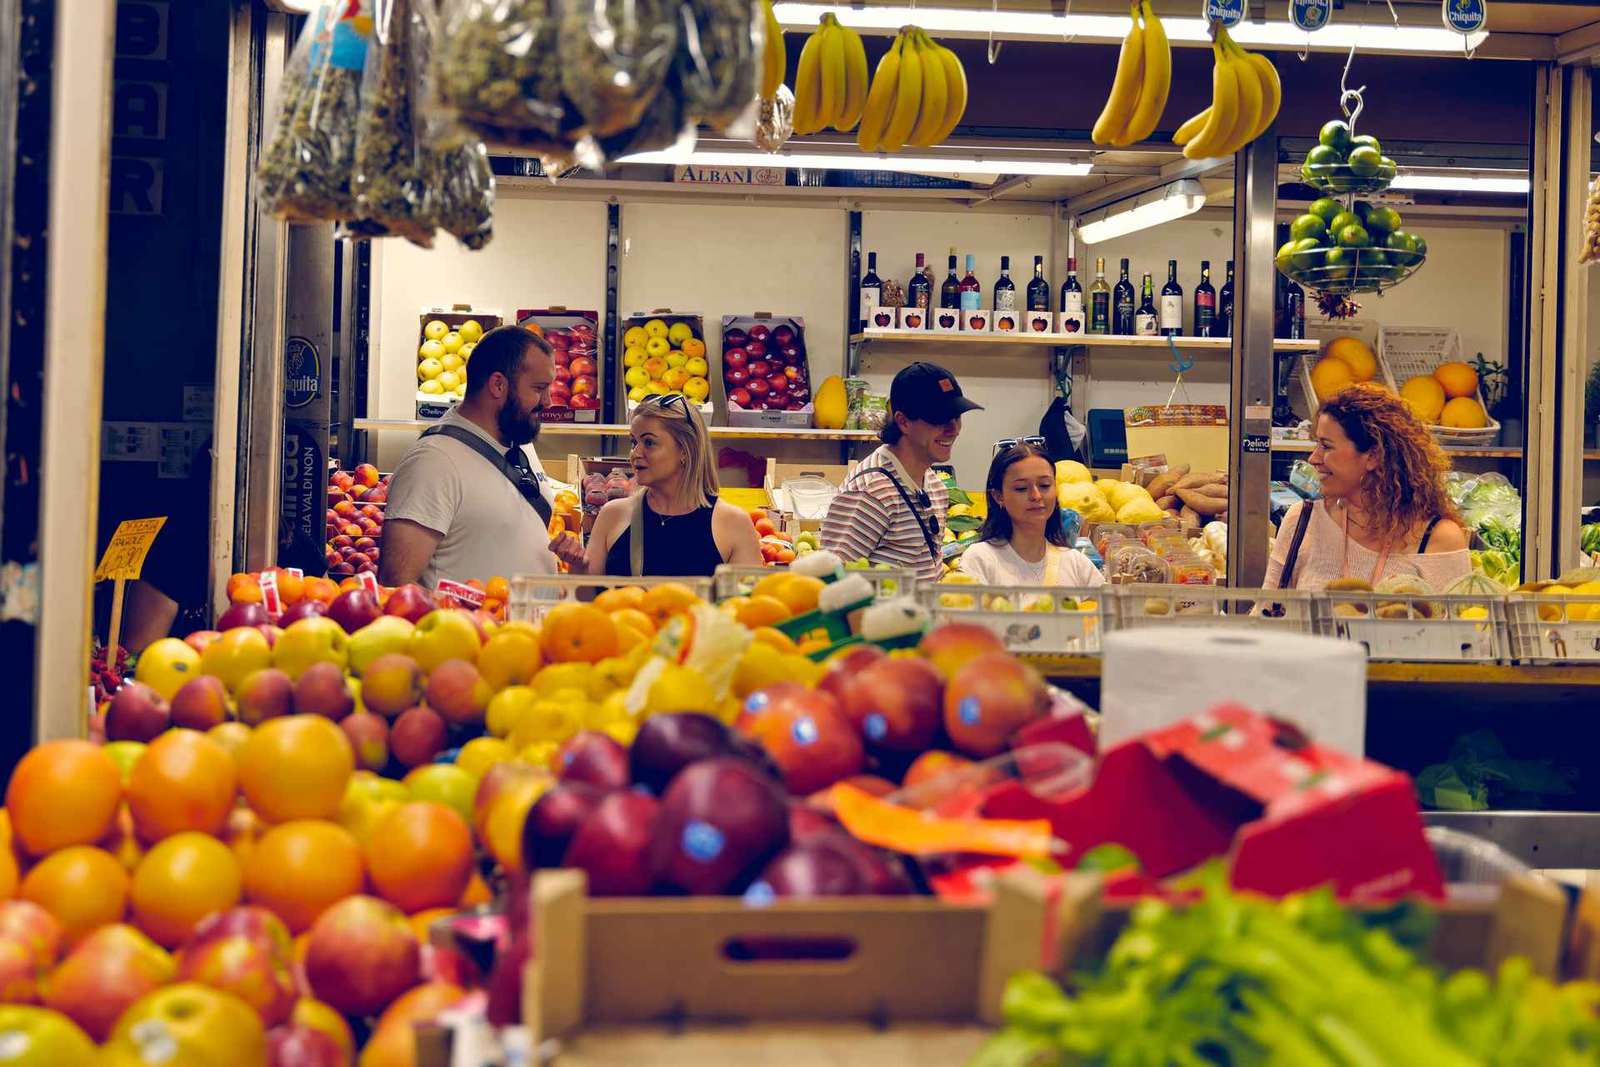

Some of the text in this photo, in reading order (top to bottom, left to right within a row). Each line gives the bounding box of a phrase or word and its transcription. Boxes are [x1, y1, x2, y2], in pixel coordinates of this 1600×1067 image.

[1208, 5, 1241, 20] Chiquita
[1450, 11, 1482, 24] Chiquita
[304, 446, 314, 476] NON
[303, 478, 313, 490] DI
[302, 492, 312, 513] VAL
